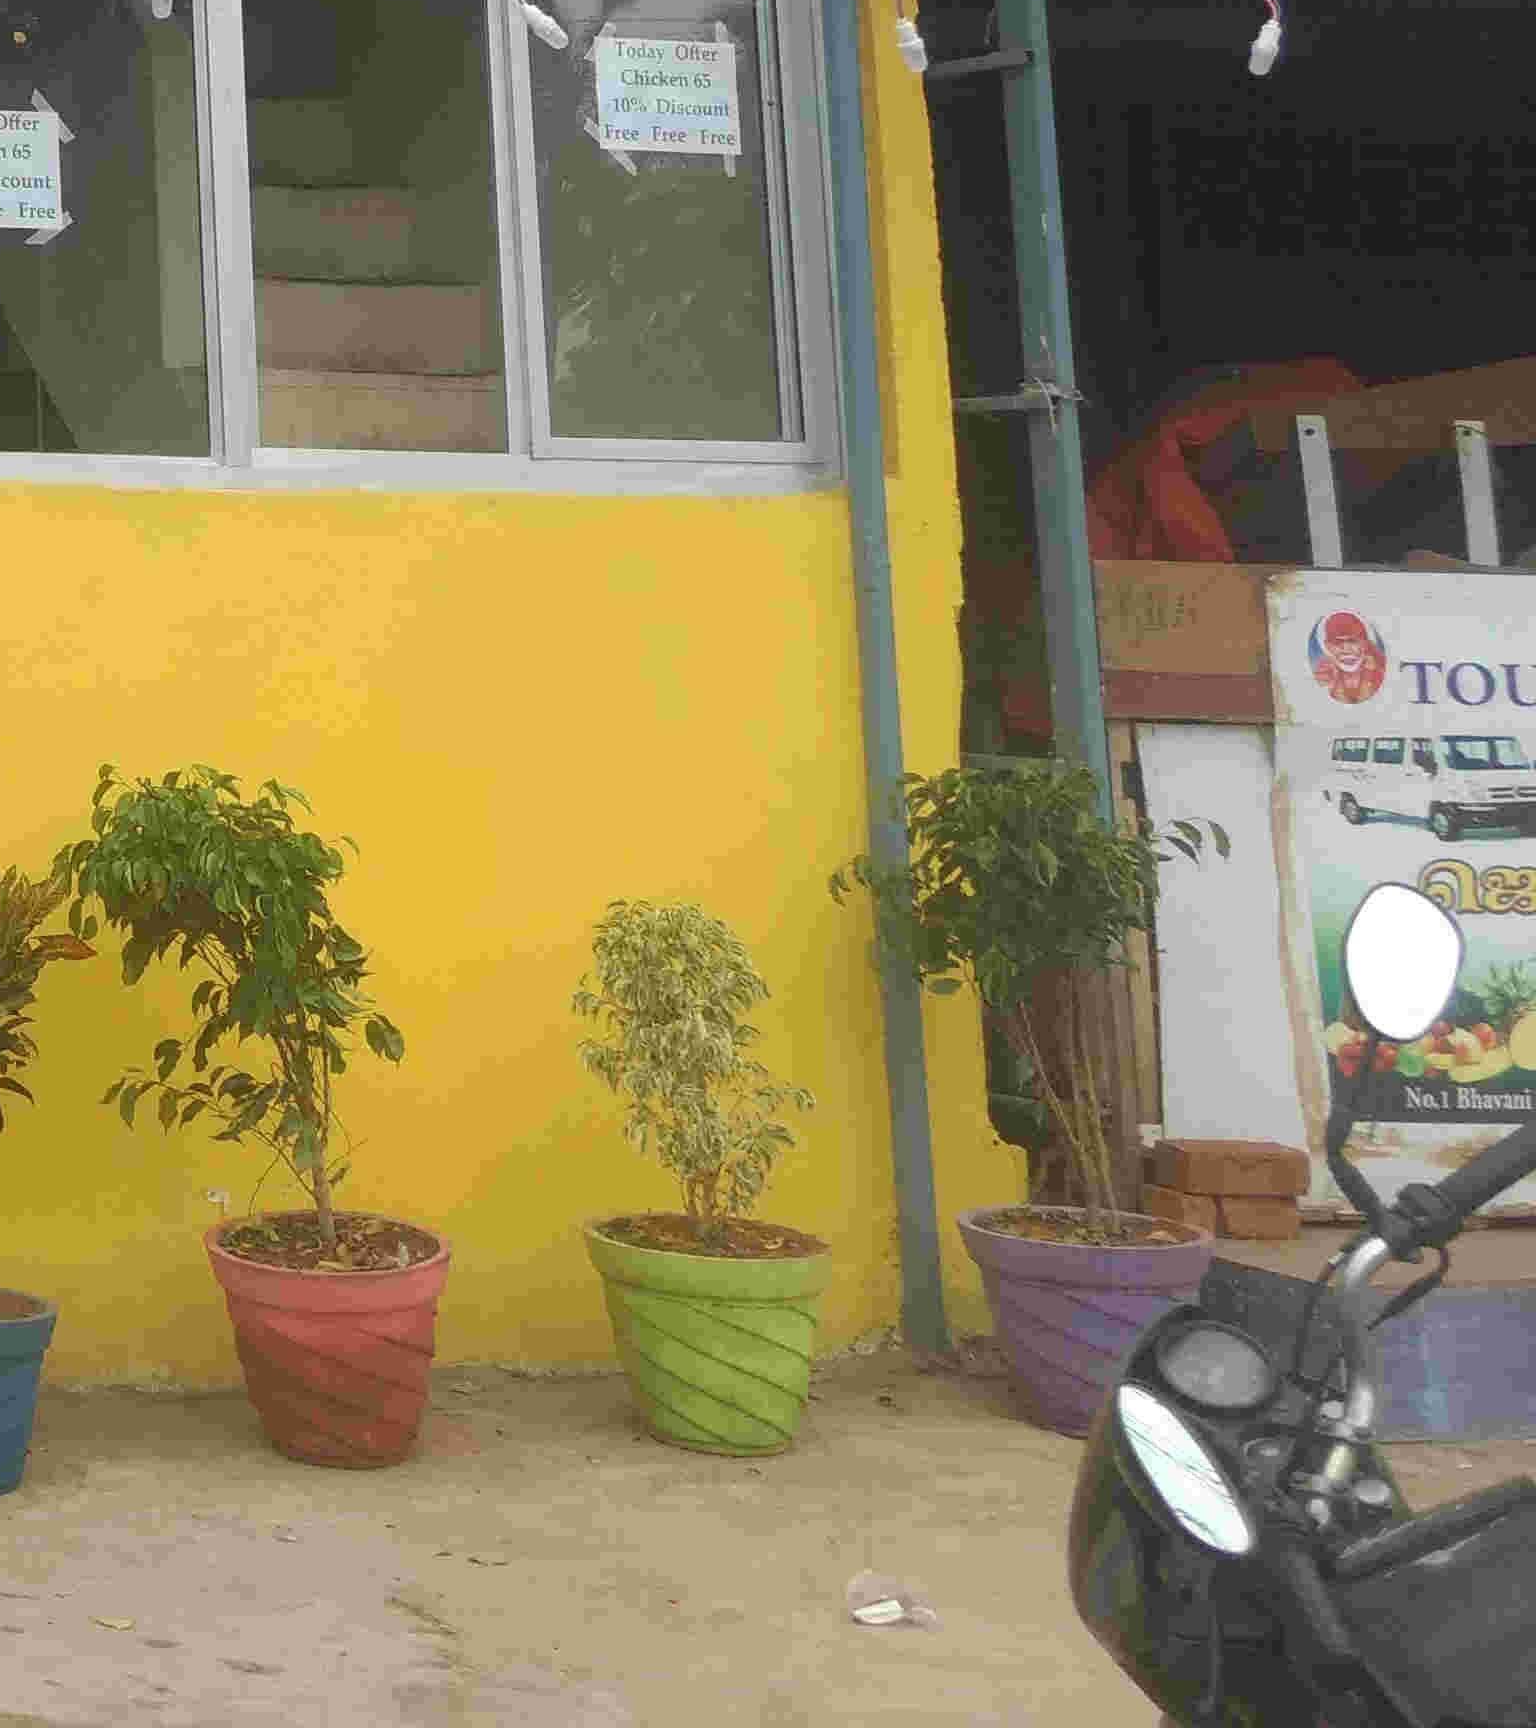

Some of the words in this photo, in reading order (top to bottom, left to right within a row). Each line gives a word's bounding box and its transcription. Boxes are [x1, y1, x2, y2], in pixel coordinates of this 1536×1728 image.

[616, 41, 666, 65] Today
[675, 43, 720, 62] Offer
[621, 69, 689, 88] Chicken
[693, 72, 712, 89] 65
[613, 98, 648, 114] 10%
[655, 99, 729, 118] Discount
[603, 124, 641, 142] Free
[650, 126, 688, 143] Free
[698, 129, 736, 146] Free
[11, 143, 32, 160] 65
[17, 202, 57, 220] Free
[1455, 1085, 1535, 1111] Bhavani
